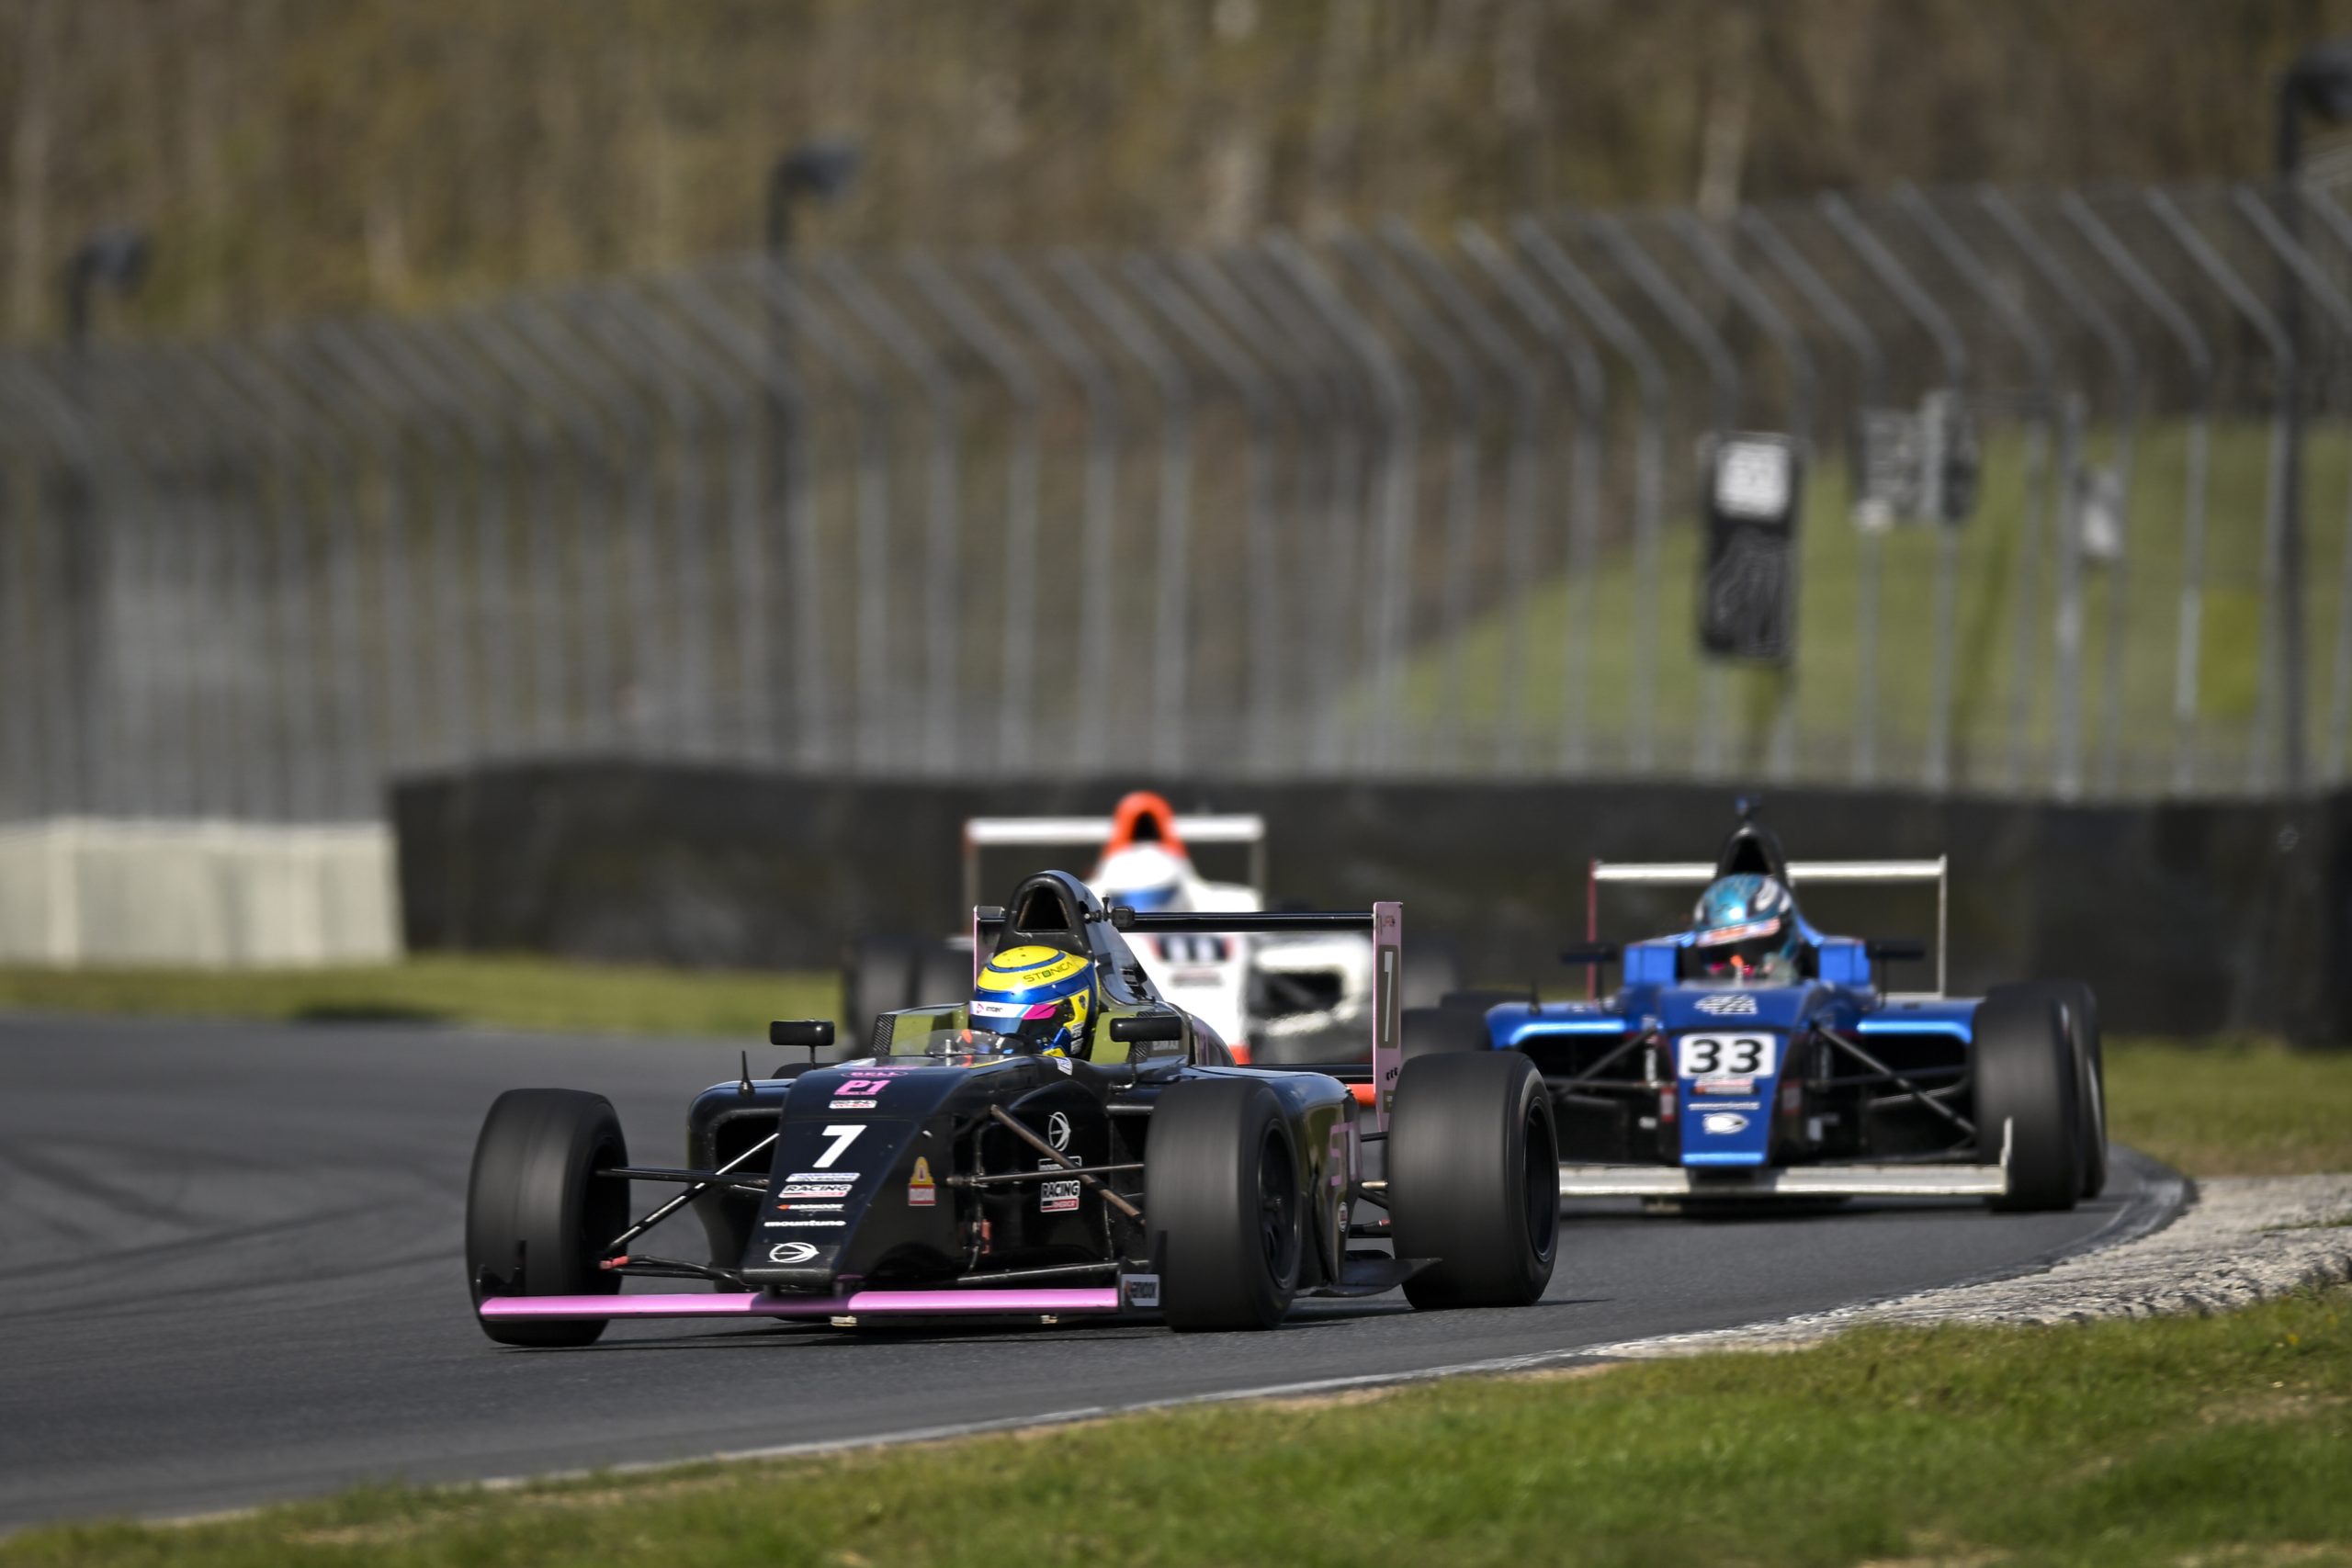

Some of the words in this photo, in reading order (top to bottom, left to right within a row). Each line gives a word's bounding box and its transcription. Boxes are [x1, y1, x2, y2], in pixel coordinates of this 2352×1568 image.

[1689, 1038, 1762, 1074] 33
[834, 1079, 891, 1094] P1
[812, 1124, 867, 1168] 7
[1041, 1180, 1080, 1198] RACING
